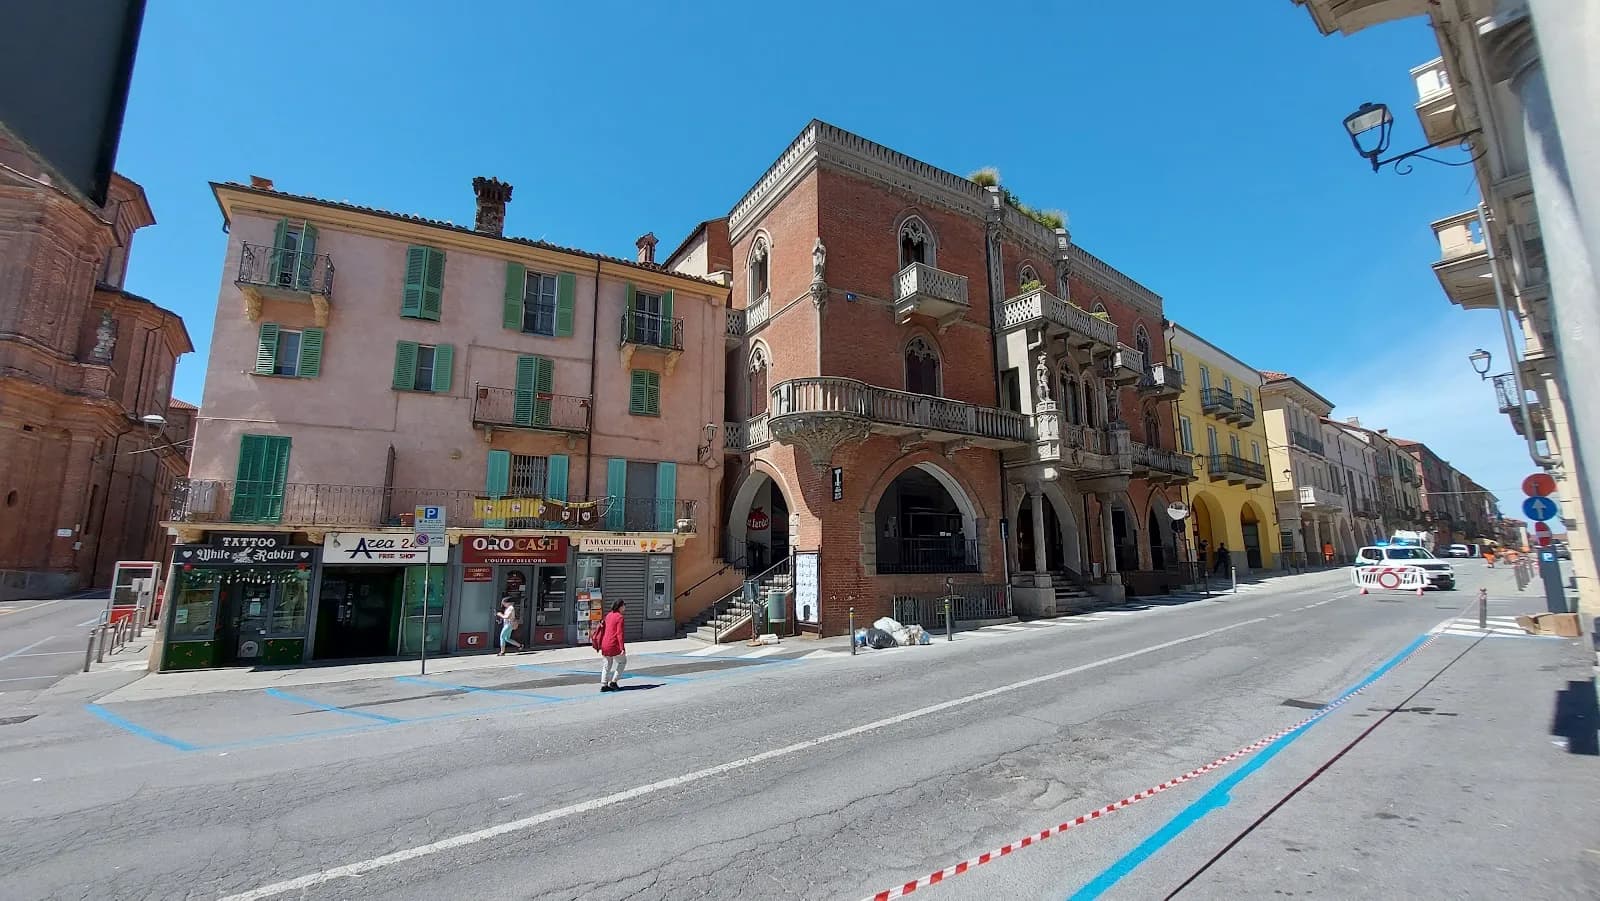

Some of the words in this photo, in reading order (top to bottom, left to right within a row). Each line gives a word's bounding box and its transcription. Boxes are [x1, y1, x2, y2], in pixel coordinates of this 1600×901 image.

[426, 508, 436, 519] P
[222, 537, 276, 548] TATTOO
[585, 538, 637, 546] TABACCHERIA
[349, 537, 395, 559] Area
[196, 548, 231, 561] White
[253, 548, 295, 562] Rabbit
